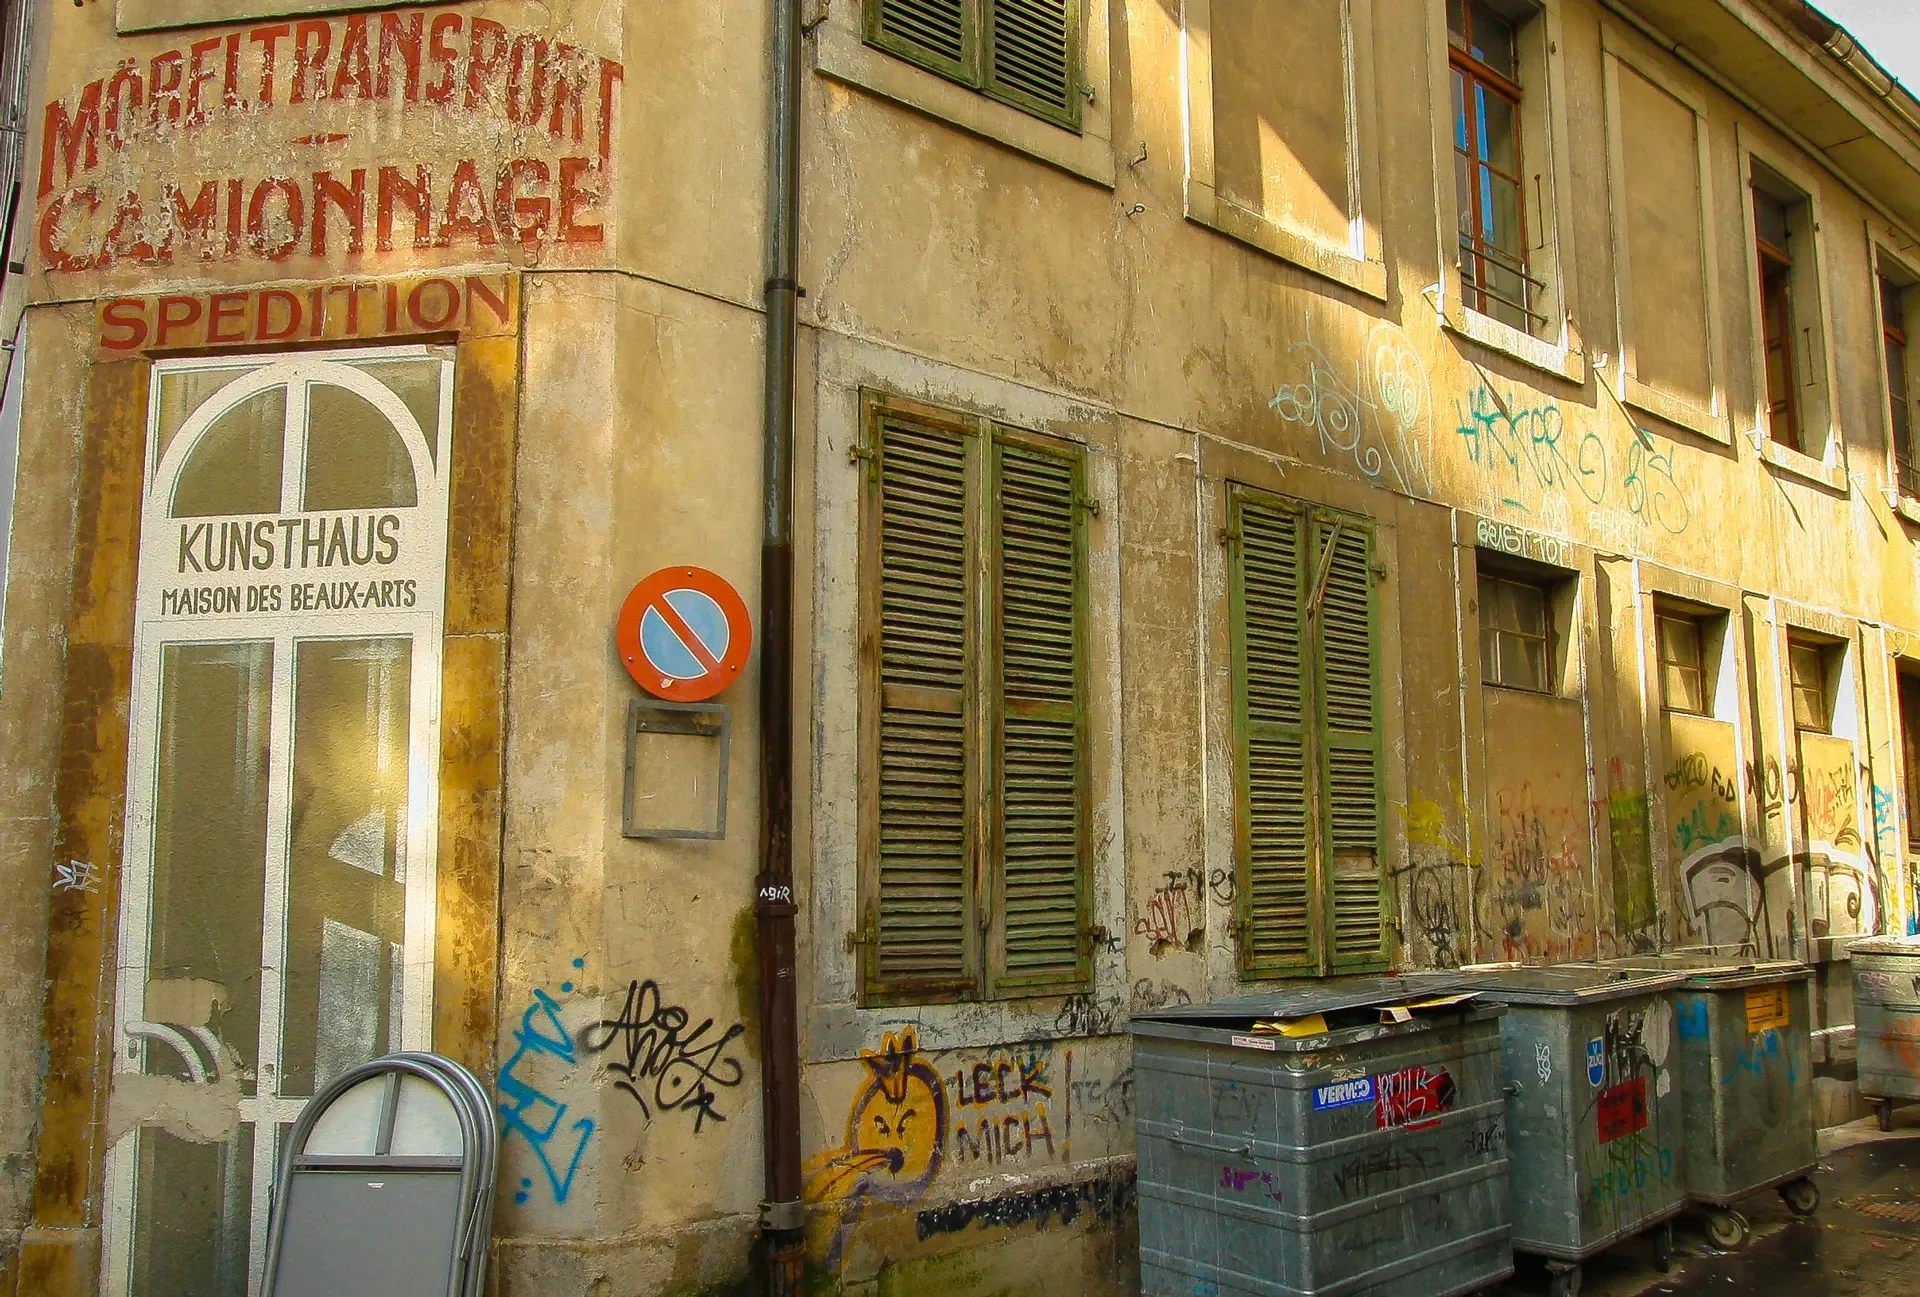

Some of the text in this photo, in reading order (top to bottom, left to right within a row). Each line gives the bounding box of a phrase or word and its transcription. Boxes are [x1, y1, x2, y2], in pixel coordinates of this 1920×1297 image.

[39, 157, 604, 273] CAMIONNAGE
[101, 276, 516, 350] SPEDITION
[178, 515, 400, 573] KUNSTHAUS
[161, 579, 417, 615] MAISON DES BEAUX-ARTS
[955, 1055, 1055, 1110] LECK
[955, 1101, 1057, 1166] MICH
